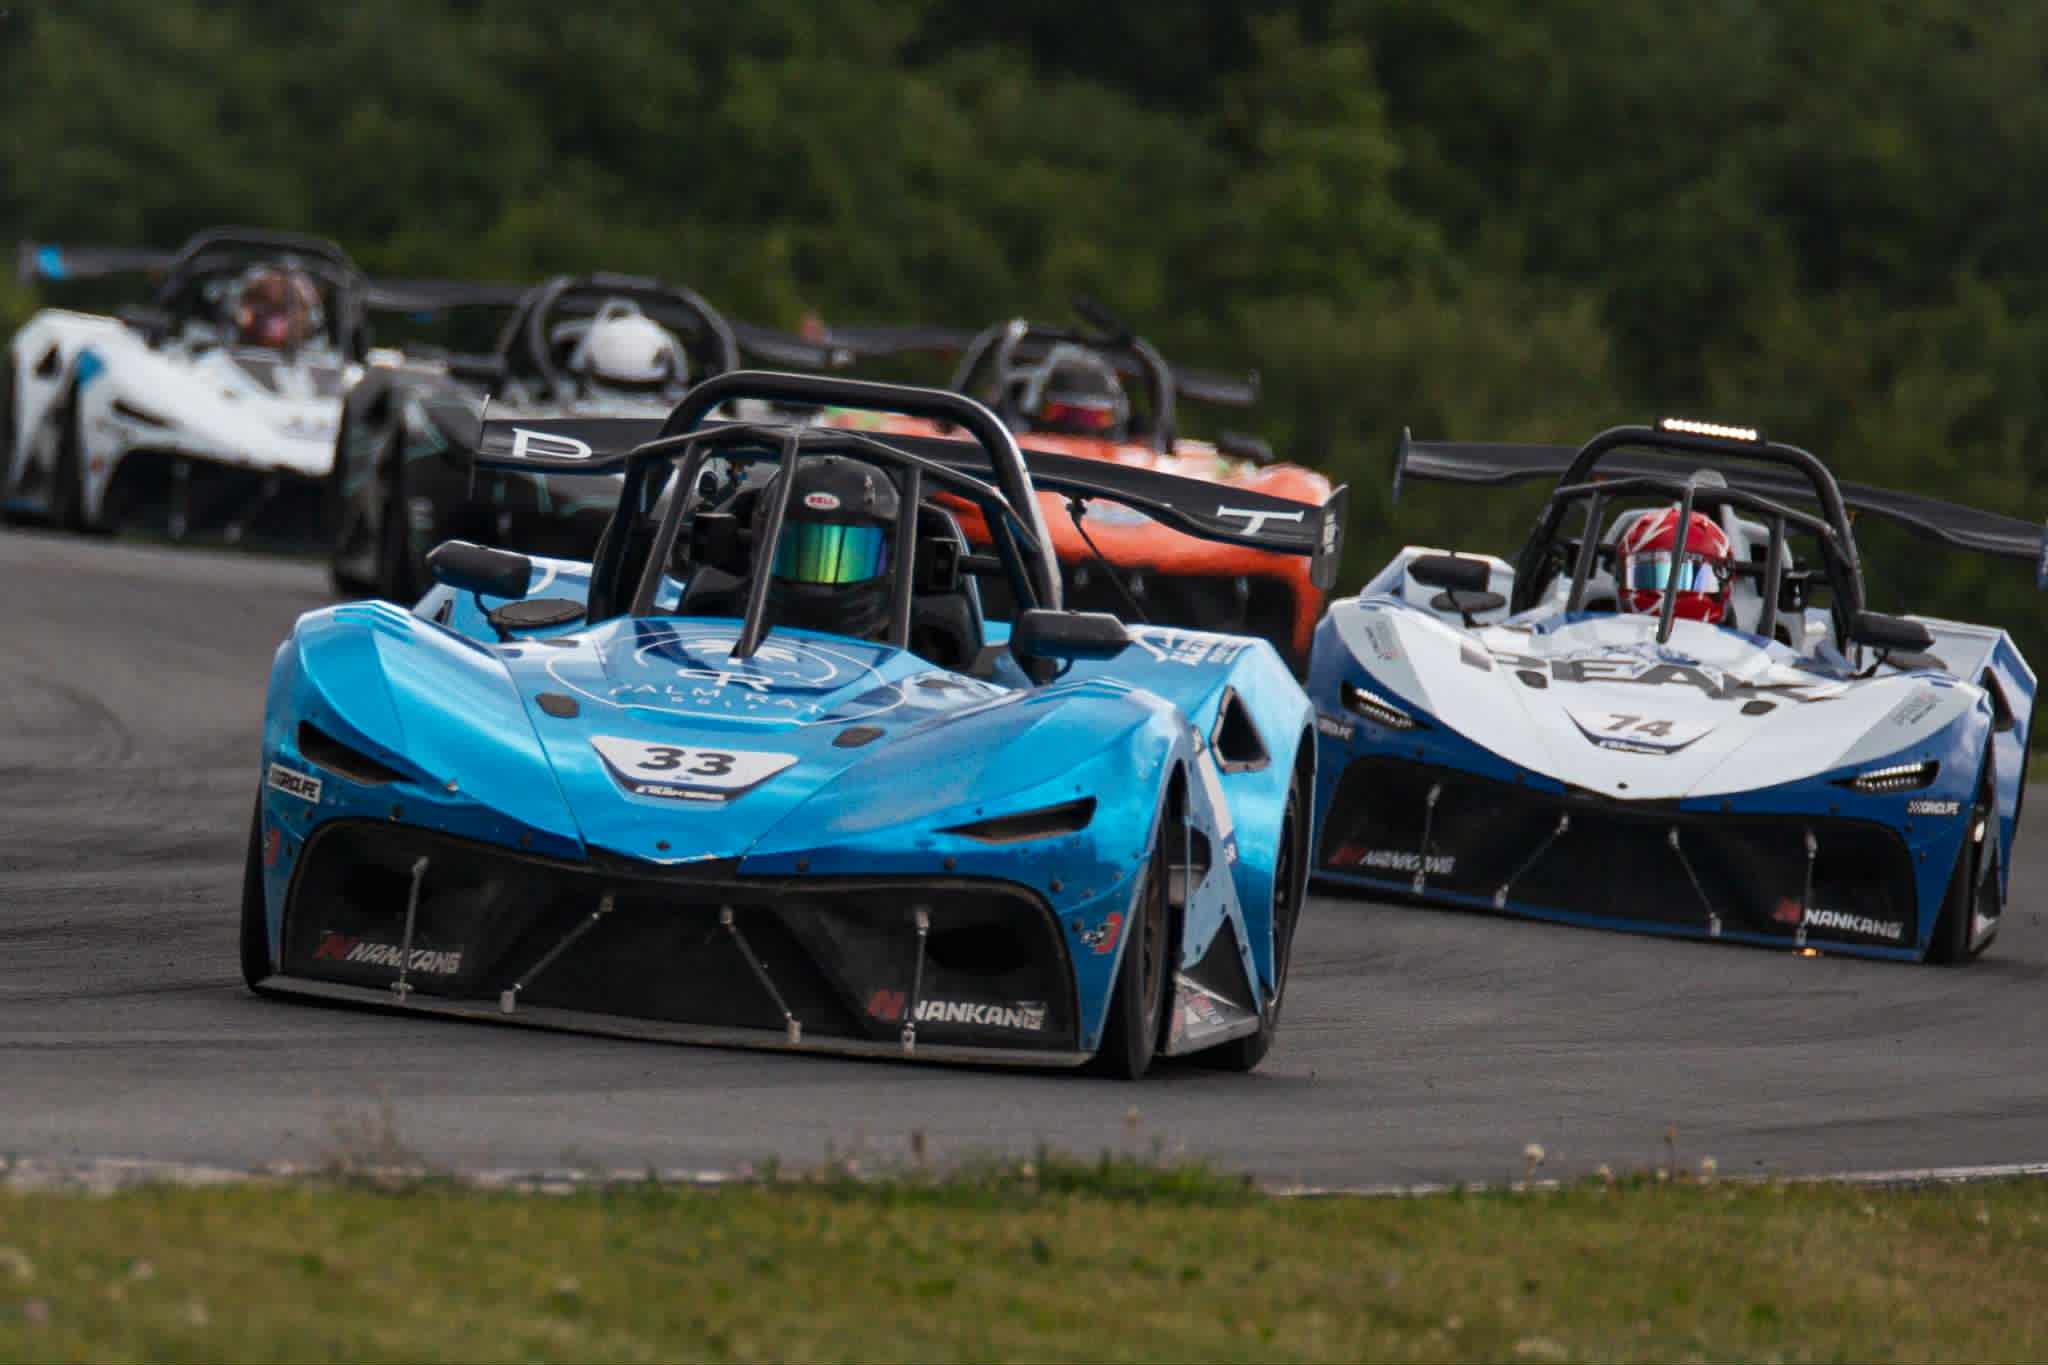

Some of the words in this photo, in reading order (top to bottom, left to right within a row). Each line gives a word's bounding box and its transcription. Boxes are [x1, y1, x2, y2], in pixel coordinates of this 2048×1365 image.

[808, 494, 838, 507] BELL
[1602, 713, 1675, 738] 74
[636, 746, 737, 776] 33
[1803, 908, 1903, 939] NANKANG
